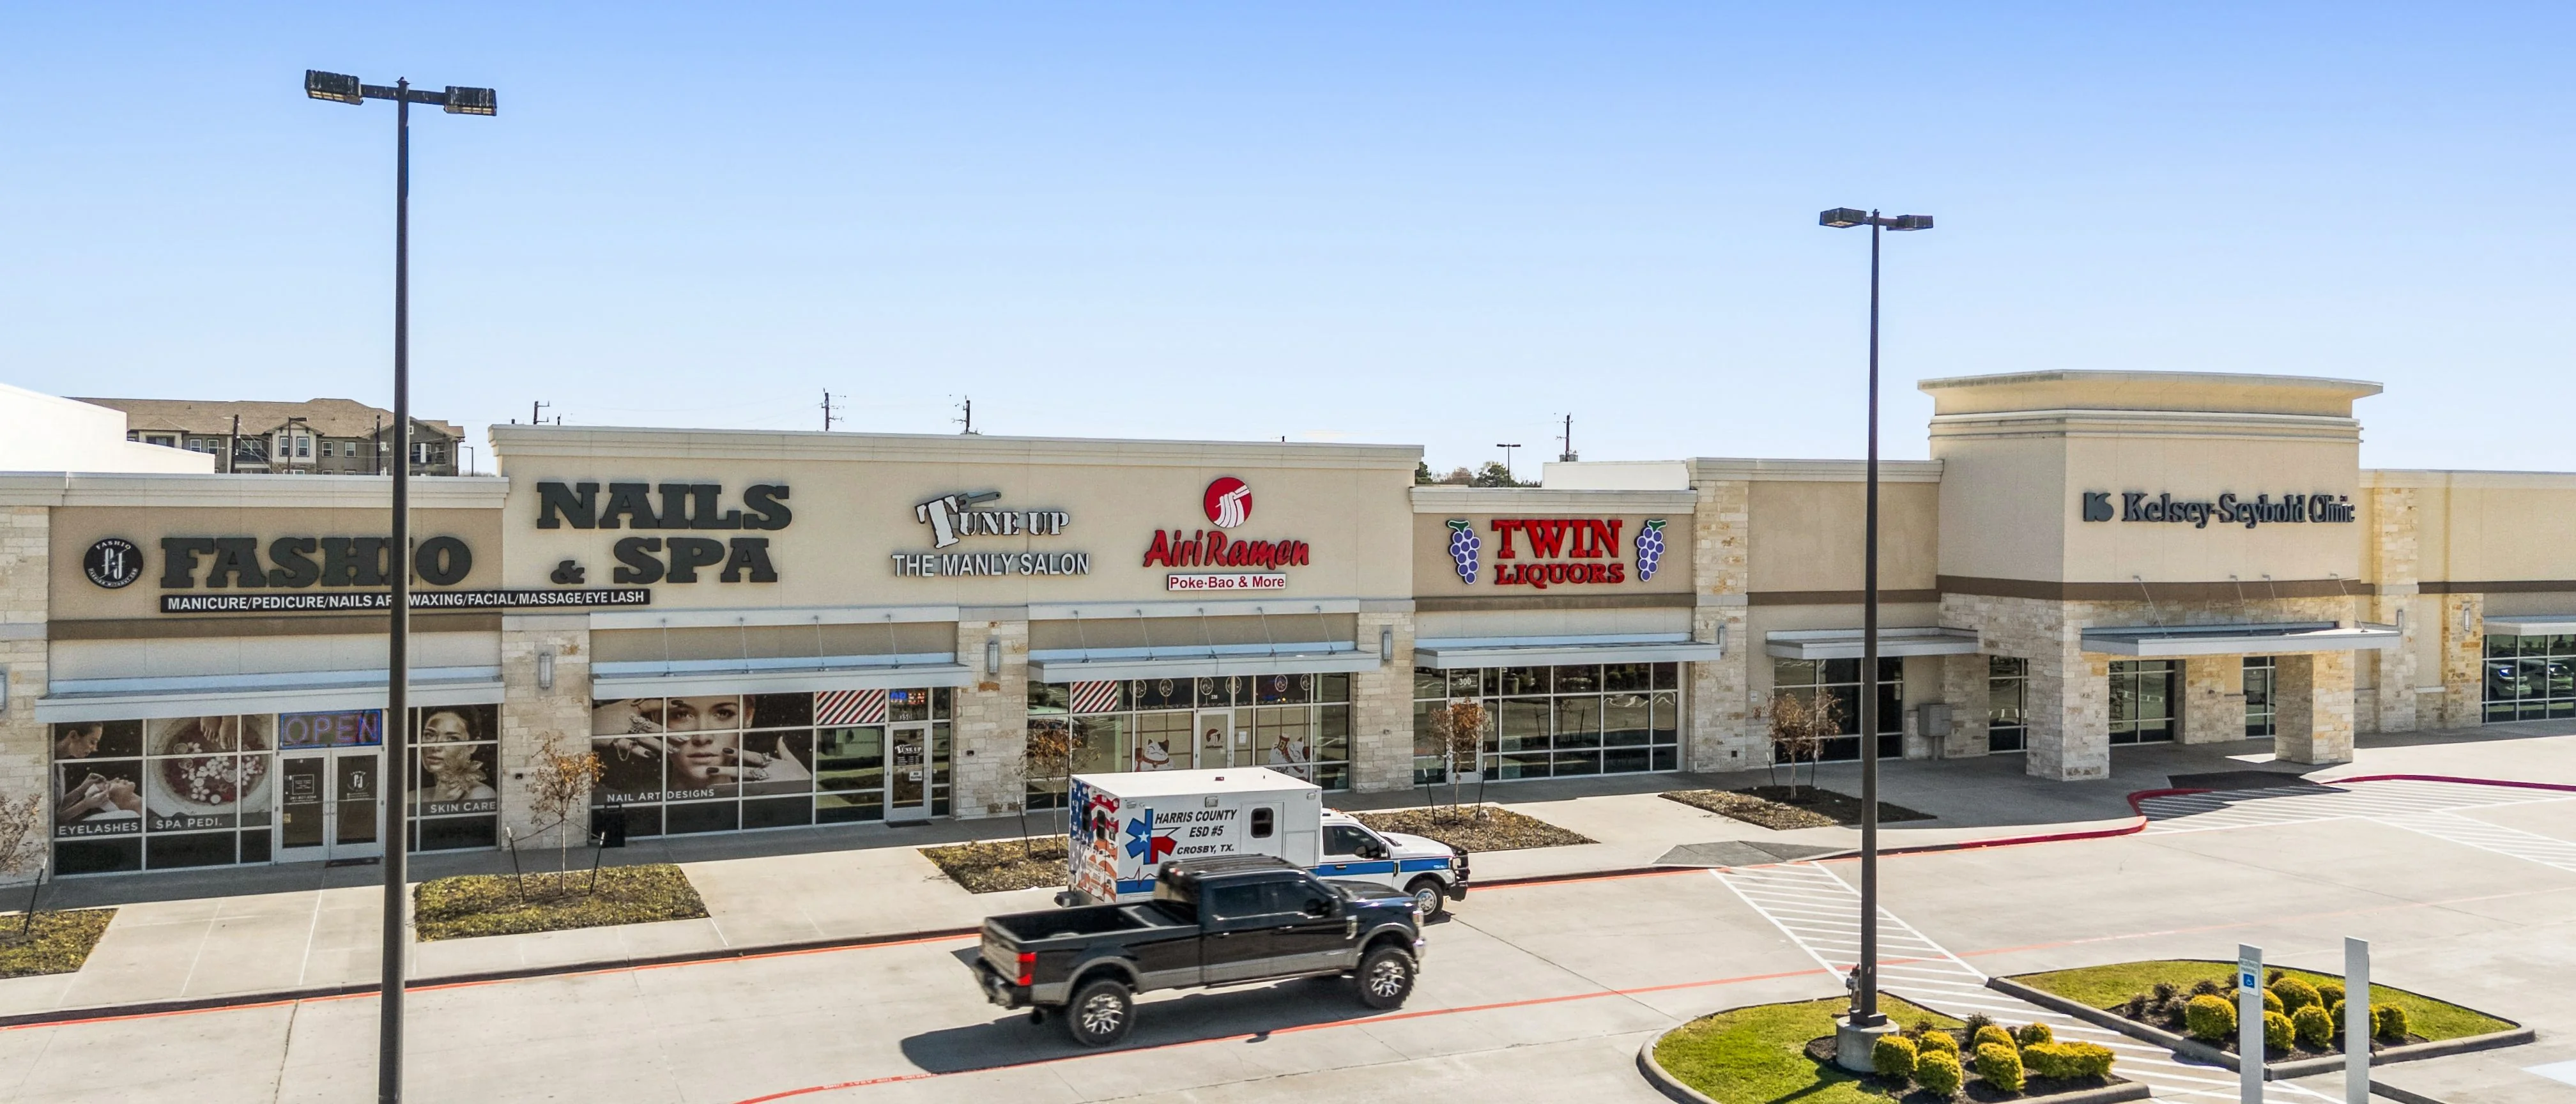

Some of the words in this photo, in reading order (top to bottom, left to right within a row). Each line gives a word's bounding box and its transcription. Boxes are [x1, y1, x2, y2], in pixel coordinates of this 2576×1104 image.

[537, 482, 792, 531] NAILS
[2121, 493, 2306, 528] Kelsey-Seybold
[2308, 494, 2356, 523] Clinic
[914, 494, 1020, 549] TUNE
[1027, 511, 1070, 535] UP
[96, 540, 131, 550] FASHIO
[1491, 519, 1623, 558] TWIN
[550, 560, 585, 585] &
[613, 537, 778, 585] SPA
[891, 554, 935, 577] THE
[942, 553, 1015, 576] MANLY
[1019, 552, 1089, 576] SALON
[1238, 576, 1248, 588] &
[1252, 576, 1284, 588] More
[1494, 562, 1625, 589] LIQUORS
[610, 592, 645, 604] LASH
[1459, 677, 1471, 686] 300
[286, 714, 378, 744] OPEN
[607, 793, 634, 802] NAIL
[638, 792, 661, 801] ART
[666, 789, 715, 799] DESIGNS
[430, 804, 459, 813] SKIN
[463, 801, 496, 811] CARE
[1155, 811, 1193, 824] HARRIS
[1195, 809, 1238, 822] COUNTY
[58, 822, 139, 836] EYELASHES
[156, 819, 181, 829] SPA
[1189, 826, 1209, 838] ESD
[1211, 825, 1224, 836] #5
[1177, 845, 1216, 855] CROSBY,
[1220, 843, 1234, 852] TX.
